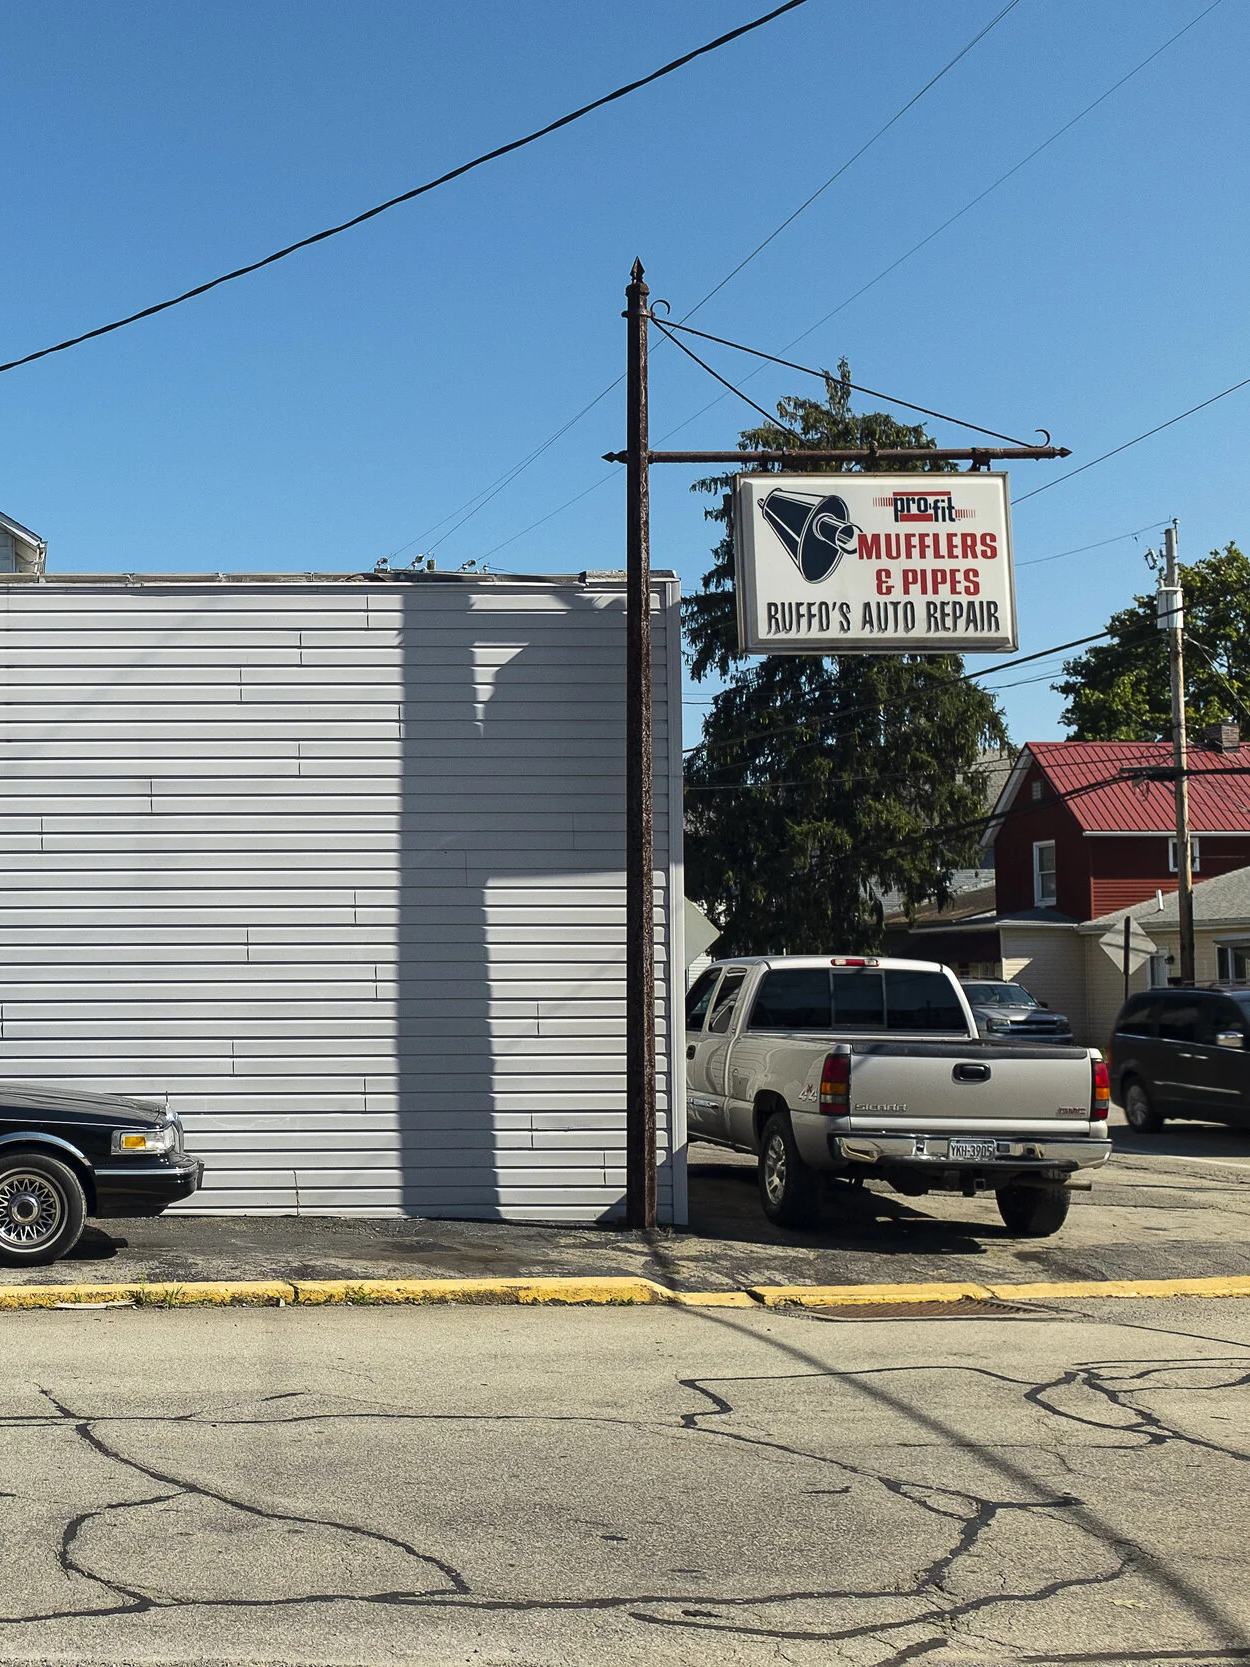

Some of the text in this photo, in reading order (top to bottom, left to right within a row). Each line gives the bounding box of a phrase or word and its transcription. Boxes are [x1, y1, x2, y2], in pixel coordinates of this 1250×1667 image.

[857, 532, 998, 560] MUFFLERS
[875, 568, 980, 596] & PIPES
[766, 600, 1000, 635] RUFFO'S AUTO REPAIR
[854, 1103, 907, 1112] SIERRA
[951, 1145, 993, 1157] YKH-3905
